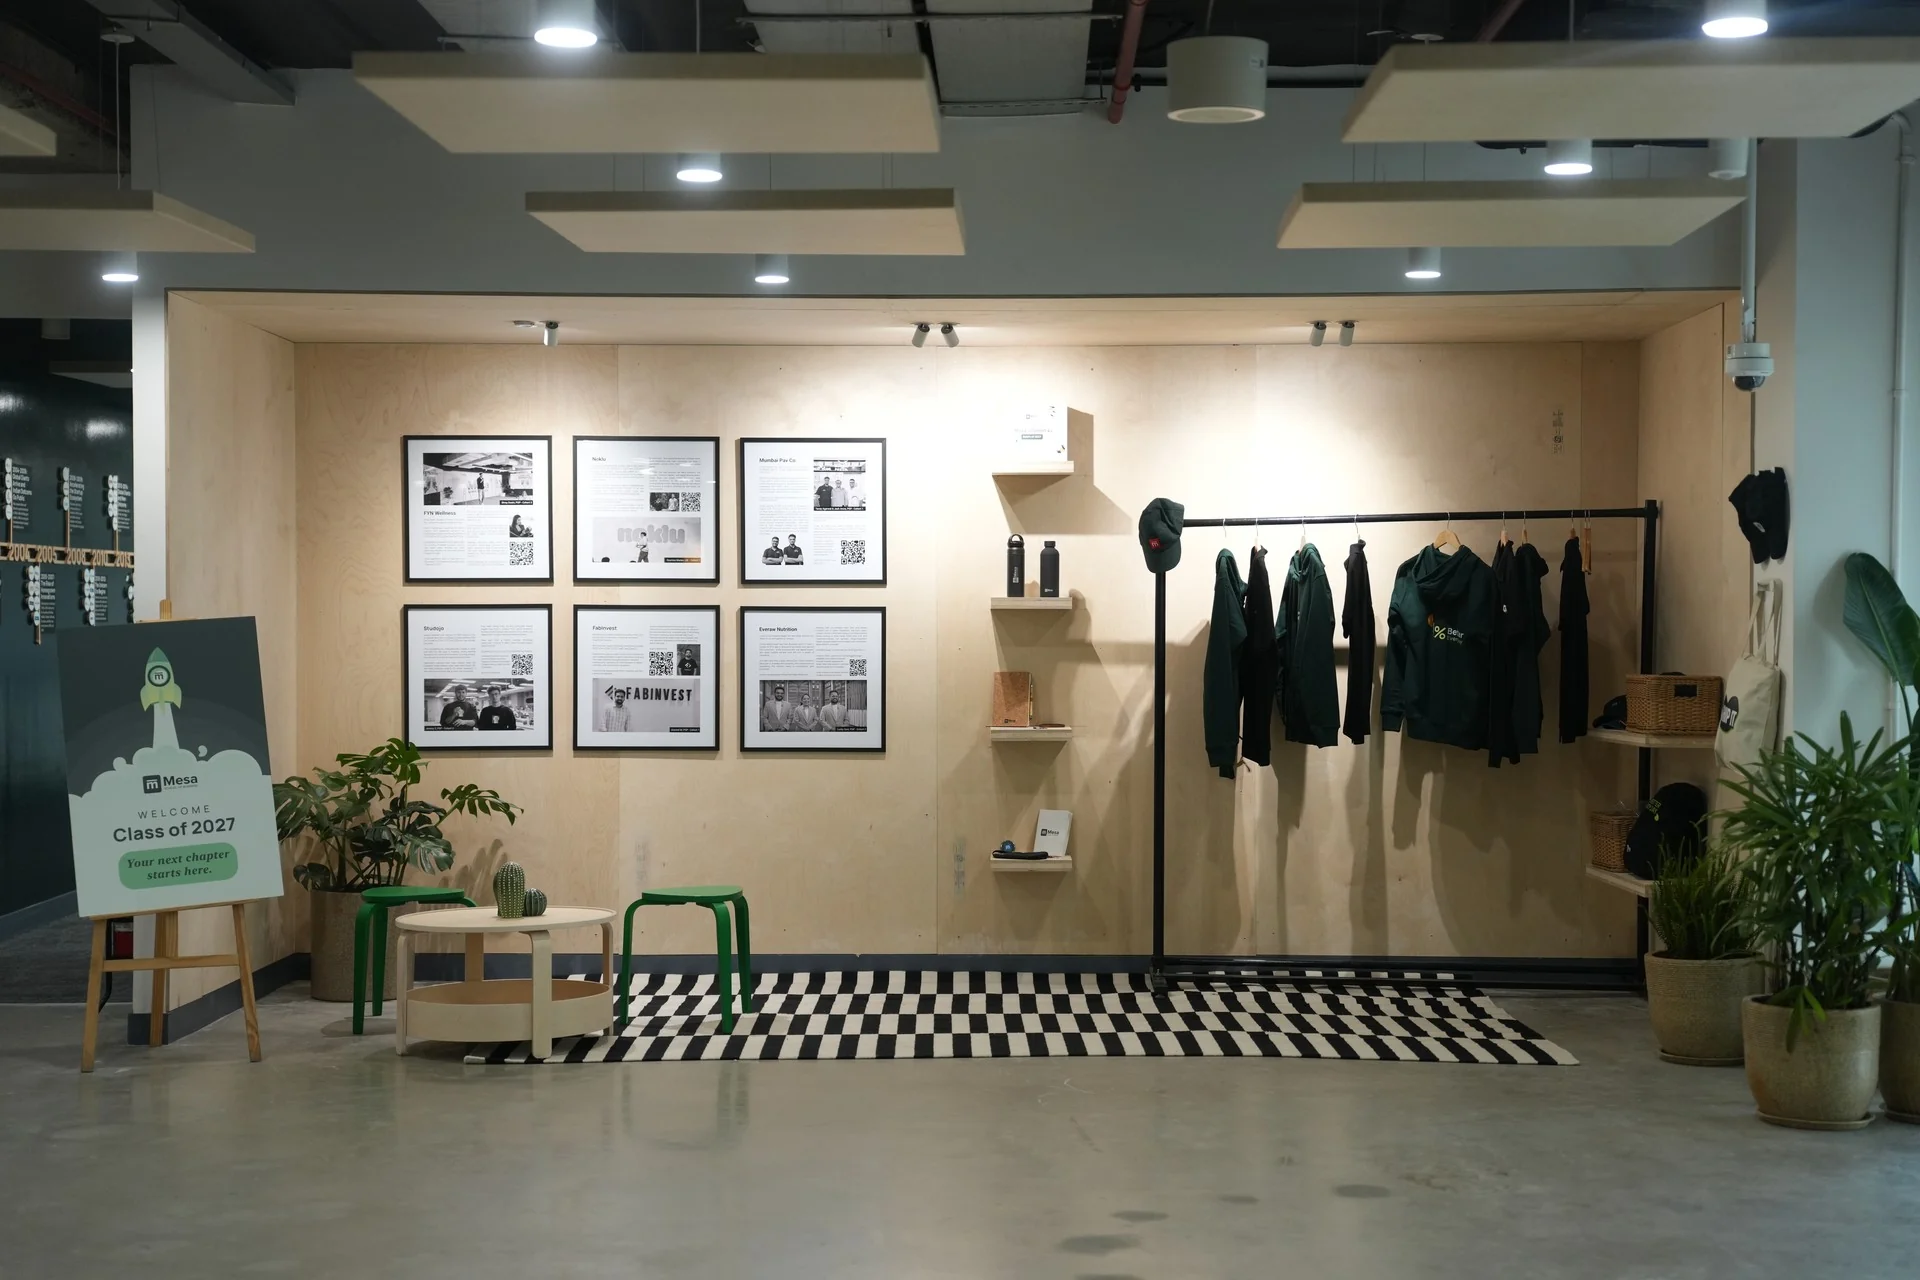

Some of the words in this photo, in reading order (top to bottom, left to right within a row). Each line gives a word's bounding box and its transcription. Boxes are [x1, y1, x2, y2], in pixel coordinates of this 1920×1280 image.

[617, 524, 686, 544] noklu
[9, 544, 30, 561] 2004
[38, 545, 57, 563] 2005
[66, 548, 86, 565] 2008
[92, 549, 108, 566] 2010
[626, 687, 692, 701] FABINVEST
[163, 775, 198, 786] Mesa
[138, 805, 211, 819] WELCOME
[113, 827, 165, 842] Class
[168, 822, 187, 837] of
[191, 817, 235, 834] 2027
[127, 859, 154, 868] Your
[158, 855, 182, 866] next
[186, 851, 230, 862] chapter
[147, 868, 181, 880] starts
[184, 866, 212, 876] here.
